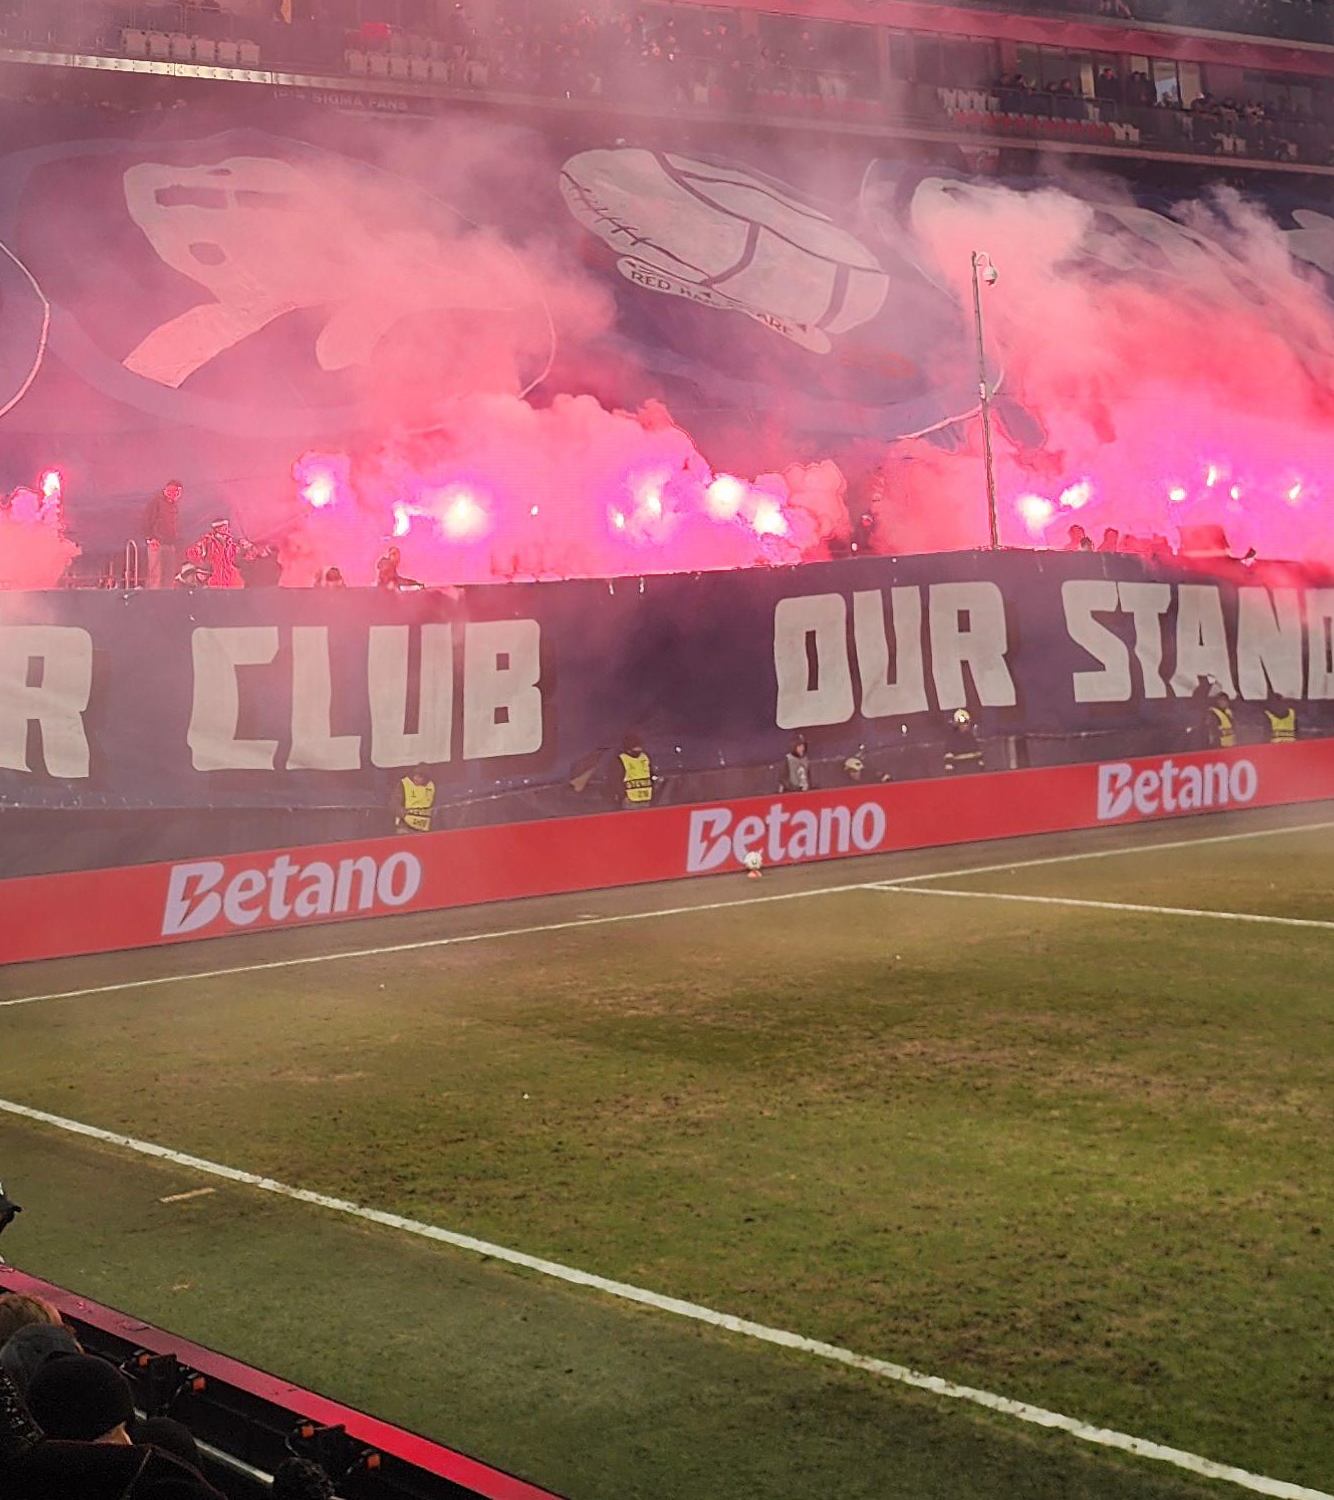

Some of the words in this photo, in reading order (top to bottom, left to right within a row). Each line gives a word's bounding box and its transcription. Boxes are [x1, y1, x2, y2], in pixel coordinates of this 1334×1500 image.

[631, 270, 671, 291] RED
[186, 618, 542, 771] CLUB
[774, 580, 1017, 730] OUR
[1097, 758, 1256, 820] Betano
[686, 801, 886, 873] Betano
[161, 848, 423, 937] Betano
